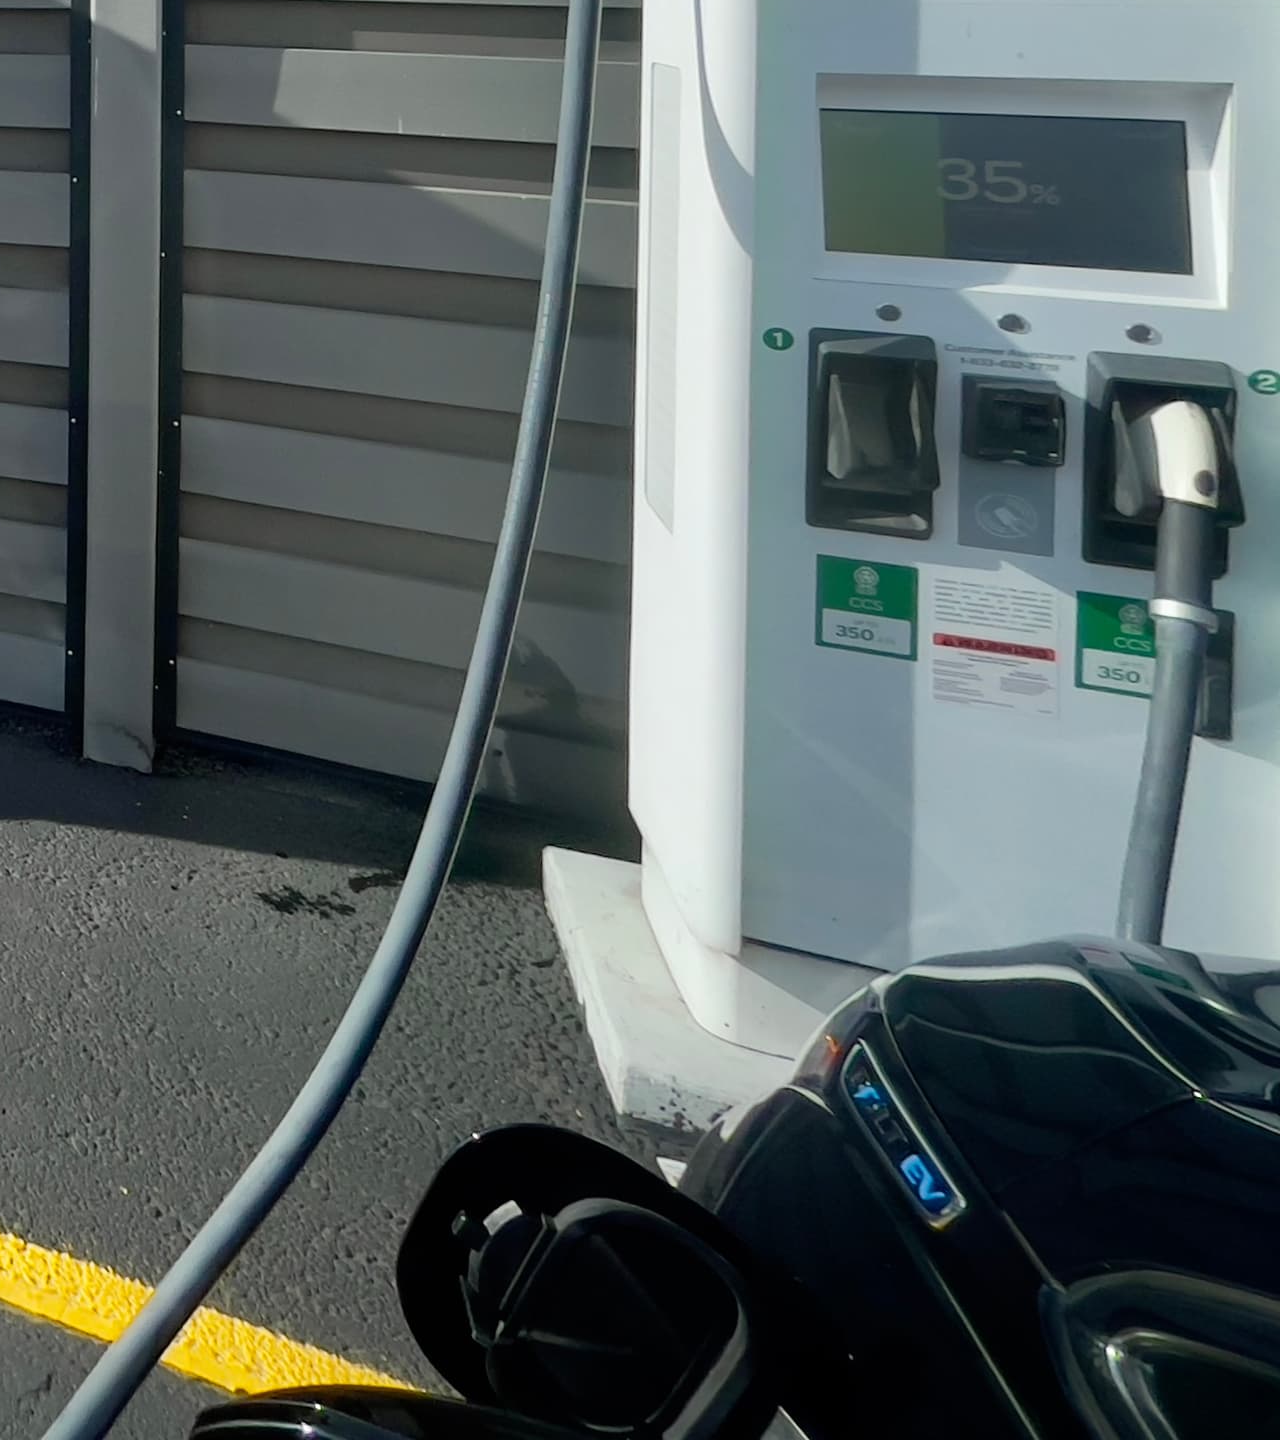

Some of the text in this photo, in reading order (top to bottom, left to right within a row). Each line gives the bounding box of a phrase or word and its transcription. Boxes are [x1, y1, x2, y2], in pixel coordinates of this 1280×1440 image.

[936, 157, 1061, 206] 35%
[848, 596, 883, 612] CCS
[835, 624, 874, 641] 350
[1113, 636, 1152, 652] CCS
[1097, 665, 1140, 683] 350
[899, 1154, 946, 1201] EV
